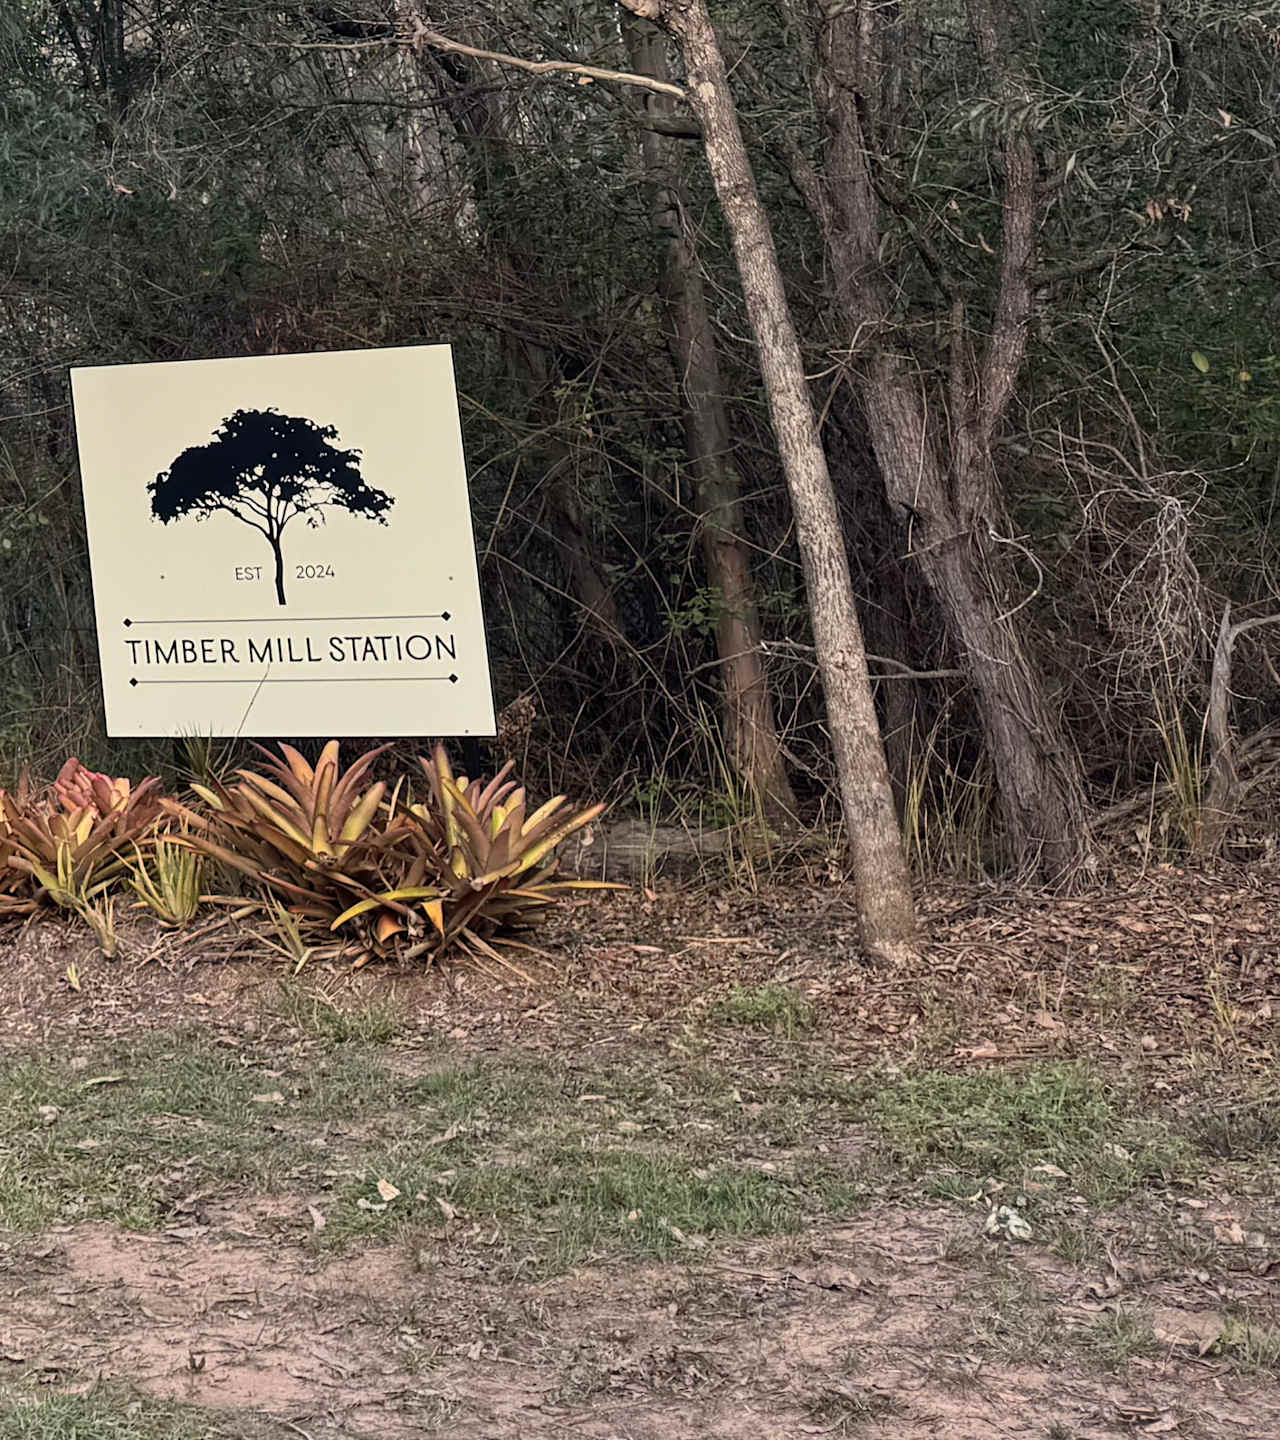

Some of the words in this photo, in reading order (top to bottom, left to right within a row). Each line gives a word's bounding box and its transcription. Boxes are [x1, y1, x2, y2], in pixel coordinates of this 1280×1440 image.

[235, 566, 263, 581] EST
[295, 564, 335, 579] 2024
[124, 638, 241, 665] TIMBER
[247, 636, 323, 664] MILL
[329, 633, 457, 663] STATION
